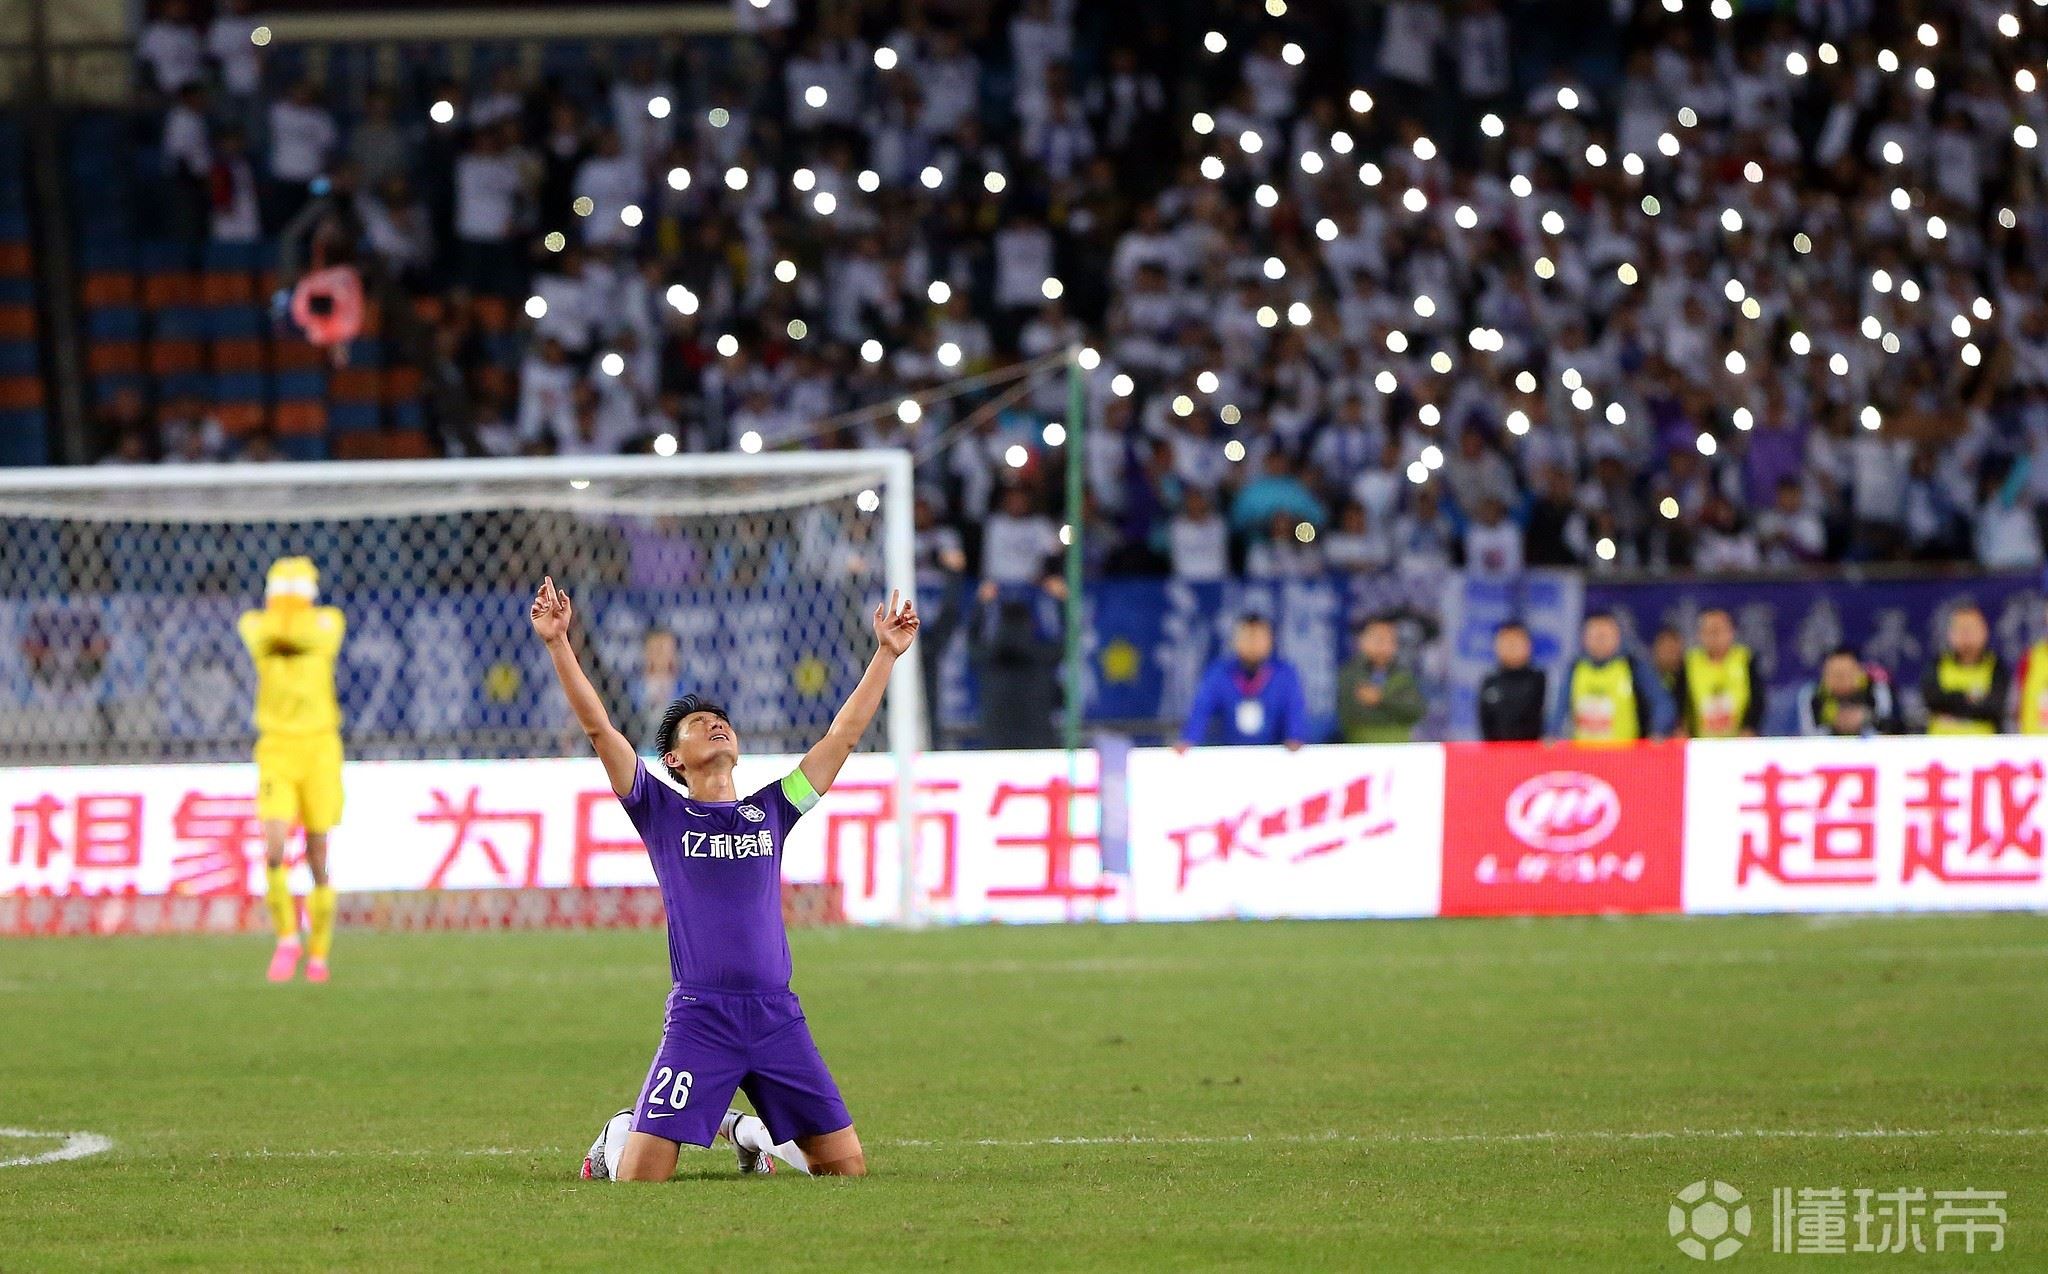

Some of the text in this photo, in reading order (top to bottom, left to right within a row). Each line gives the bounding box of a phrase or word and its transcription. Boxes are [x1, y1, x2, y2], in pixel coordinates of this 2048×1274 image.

[681, 829, 774, 860] 亿利资源
[1736, 761, 2045, 886] 超越
[648, 1066, 693, 1110] 26
